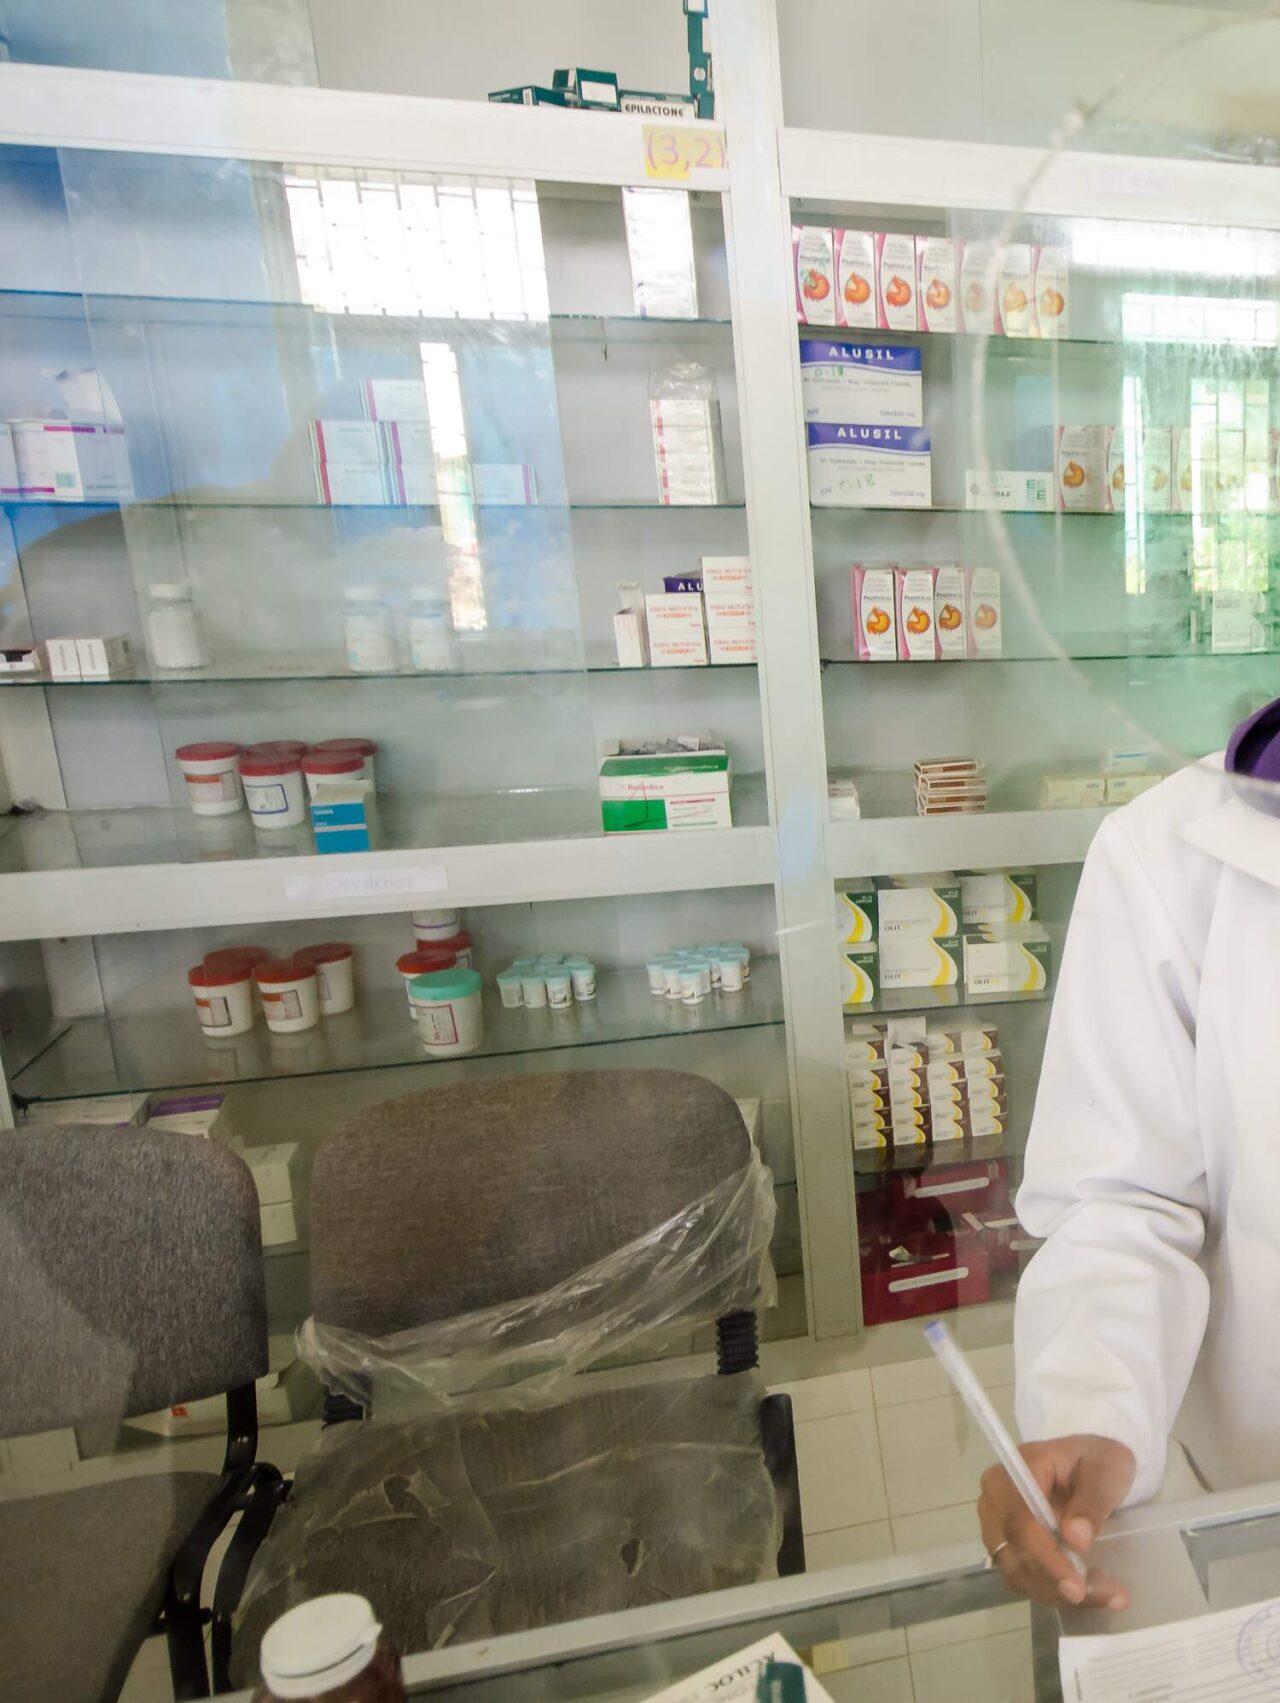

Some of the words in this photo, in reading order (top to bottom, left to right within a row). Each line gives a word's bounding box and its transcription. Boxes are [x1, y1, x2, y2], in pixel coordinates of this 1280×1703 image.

[624, 104, 684, 117] EPILACTONE
[828, 346, 894, 361] ALUSIL
[837, 427, 902, 441] ALUSIL
